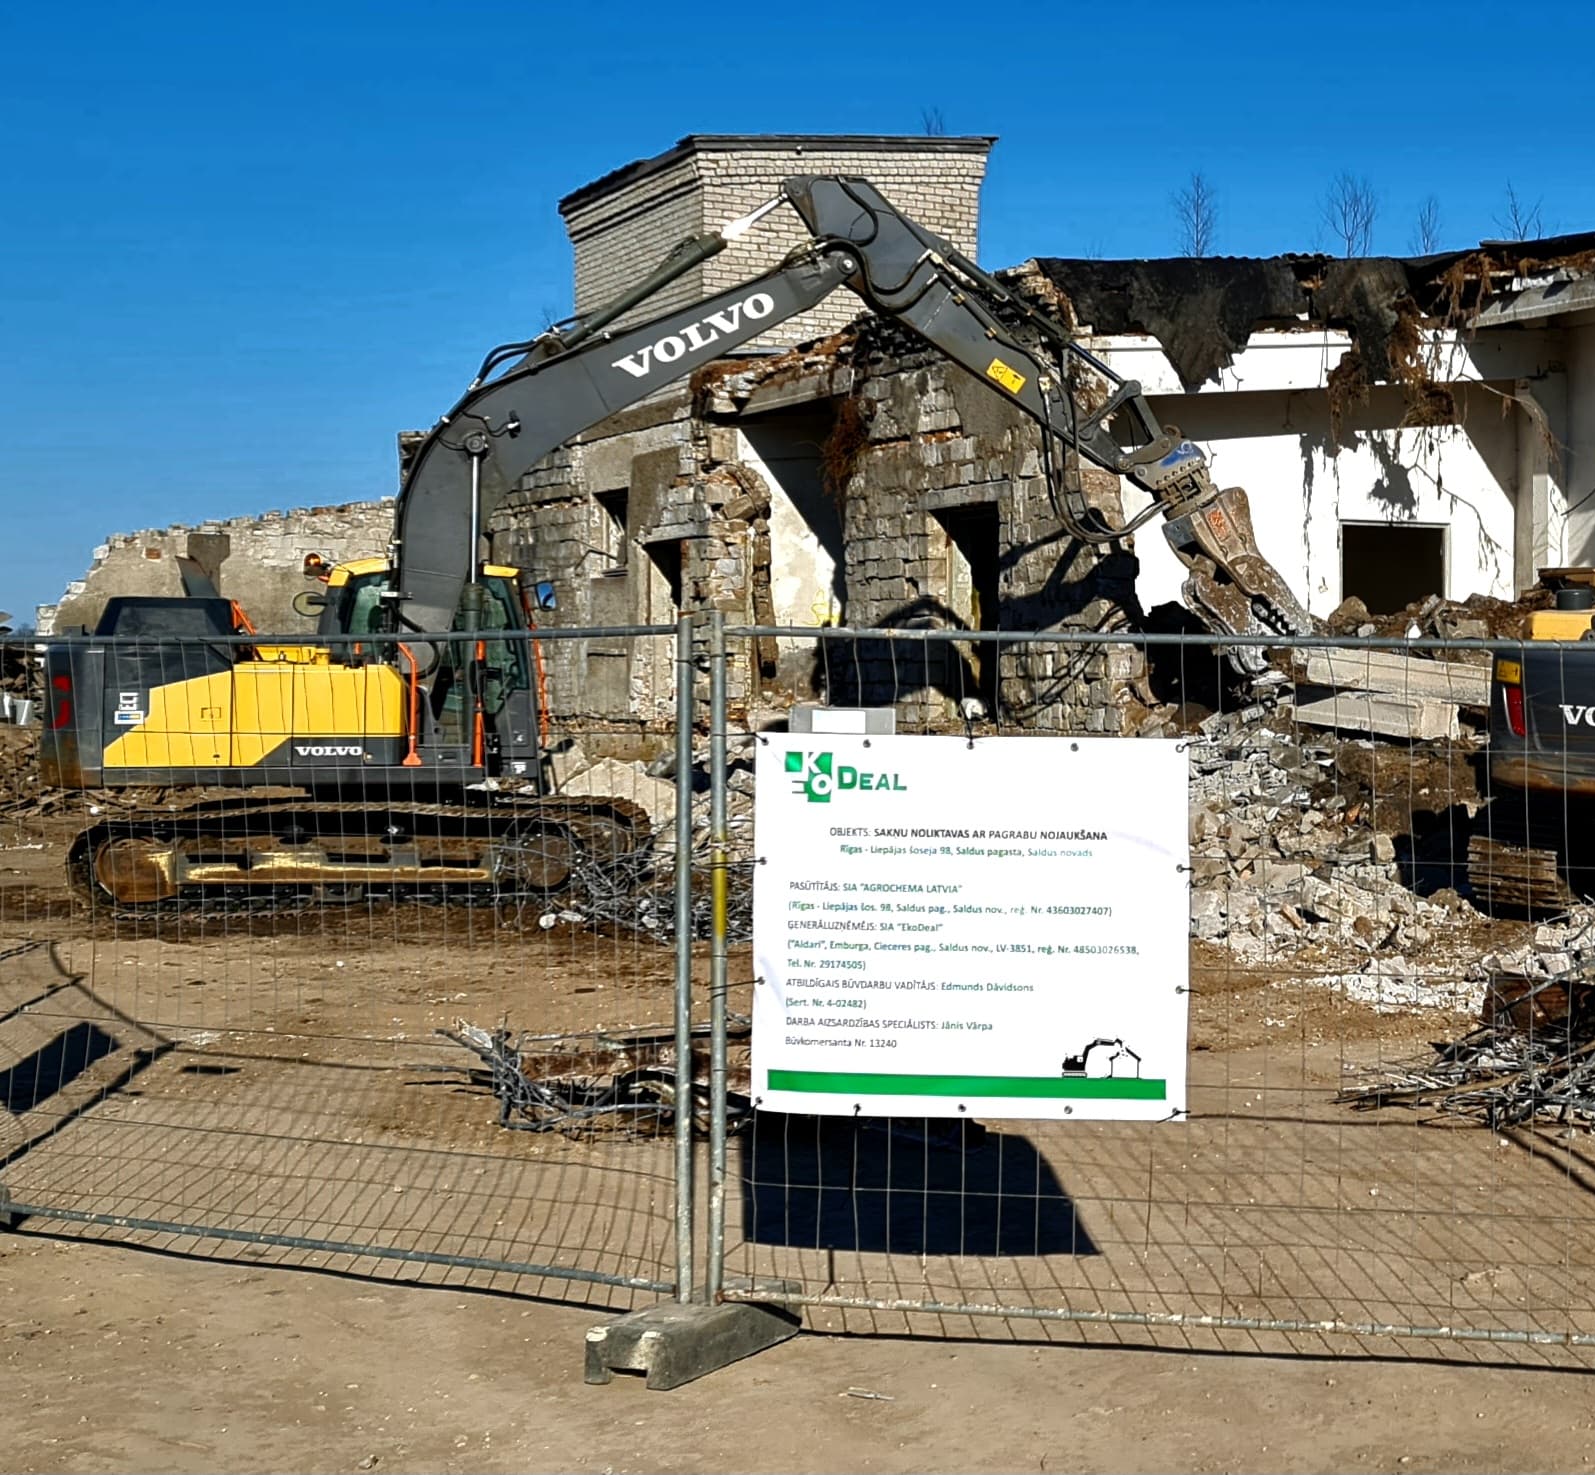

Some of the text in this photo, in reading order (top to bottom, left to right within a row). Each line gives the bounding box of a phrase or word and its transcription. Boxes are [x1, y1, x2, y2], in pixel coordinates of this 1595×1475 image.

[611, 291, 775, 378] VOLVO
[294, 746, 363, 756] VOLVO
[830, 827, 1107, 840] OBJEKTS: SAKŅU NOLIKTAVAS AR PAGRABU NOJAUKŠANA
[840, 845, 862, 855] Rīgas
[871, 846, 906, 855] Liepājas
[940, 847, 953, 856] 98,
[956, 847, 984, 855] Saldus
[987, 849, 1024, 857] pagasta,
[1028, 848, 1057, 856] Saldus
[1061, 848, 1092, 856] novads
[790, 880, 840, 891] PASŪTĪTĀJS:
[843, 883, 857, 891] SIA
[823, 902, 858, 912] Liepājas
[880, 904, 893, 912] 98,
[897, 904, 925, 912] Saldus
[953, 905, 982, 913] Saldus
[880, 923, 894, 931] SIA
[874, 942, 911, 951] Cieceres
[939, 943, 968, 951] Saldus
[996, 944, 1034, 953] LV-3851,
[786, 978, 1033, 991] ATBILDĪGAIS BŪVDARBU VADĪTĀJS: Edmunds Dāvidsons
[786, 997, 808, 1008] (Sert.
[786, 1017, 815, 1026] DARBA
[882, 1019, 938, 1029] SPECIĀLISTS:
[941, 1021, 963, 1029] Jānis
[785, 1036, 852, 1047] Būvkomersanta
[870, 1039, 897, 1048] 13240
